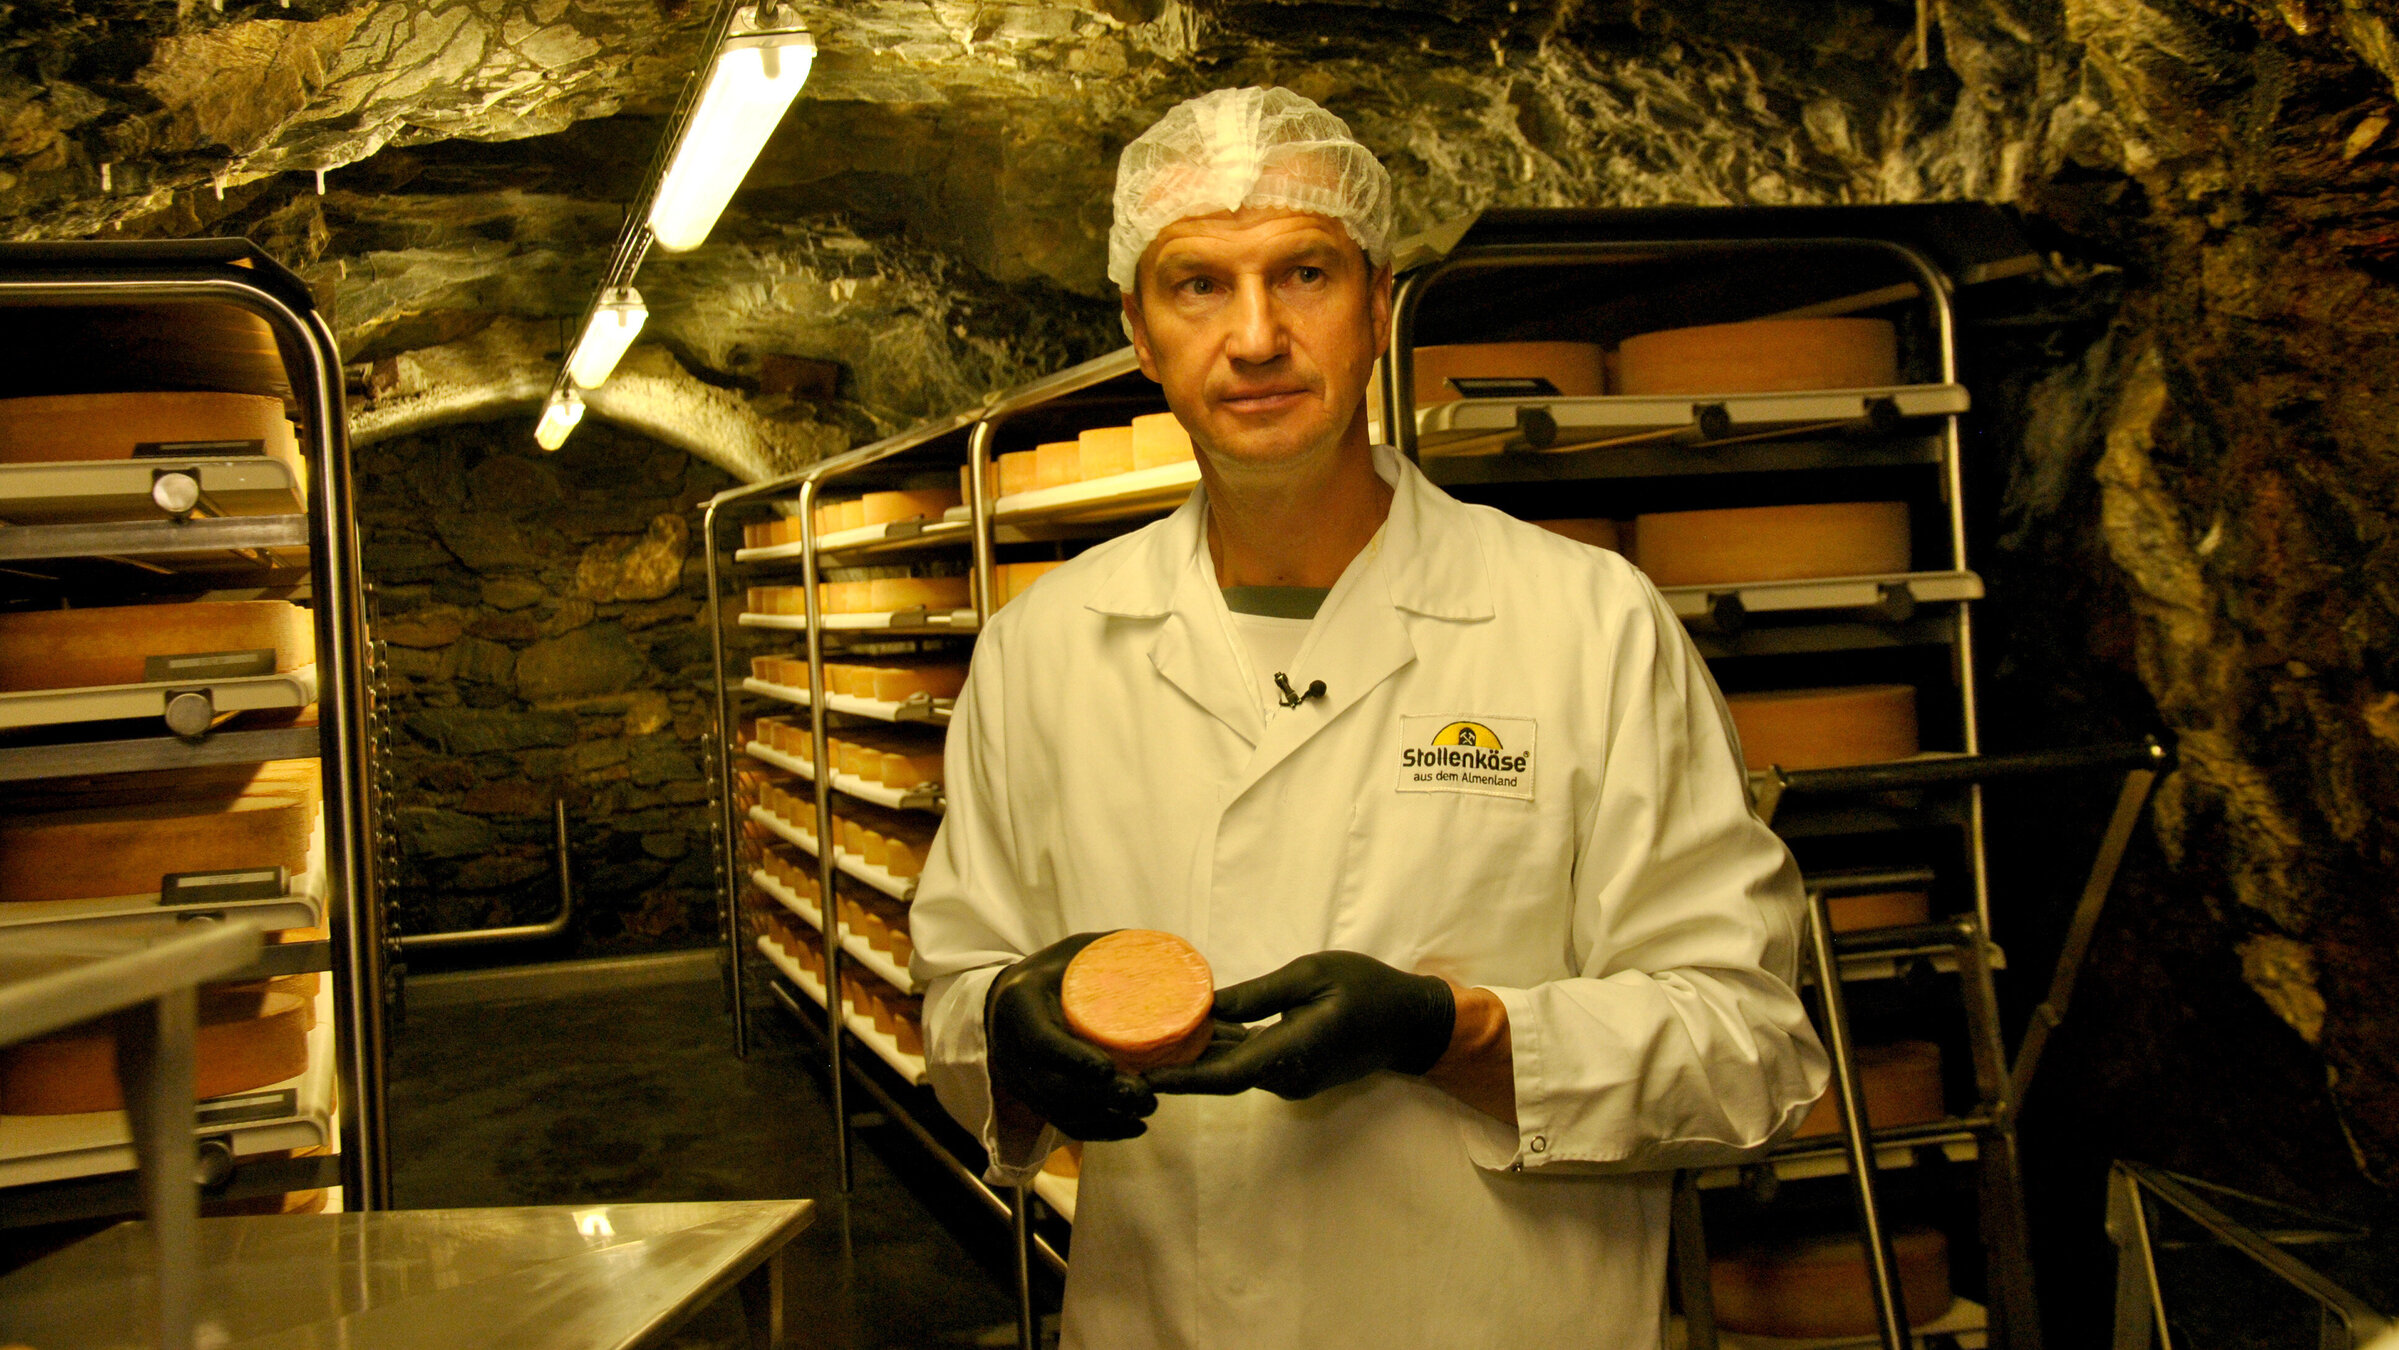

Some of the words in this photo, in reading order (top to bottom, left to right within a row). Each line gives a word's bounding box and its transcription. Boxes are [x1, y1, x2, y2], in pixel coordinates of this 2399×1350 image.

[1414, 772, 1432, 781] aus
[1436, 771, 1458, 782] dem
[1461, 772, 1517, 787] Almenland
